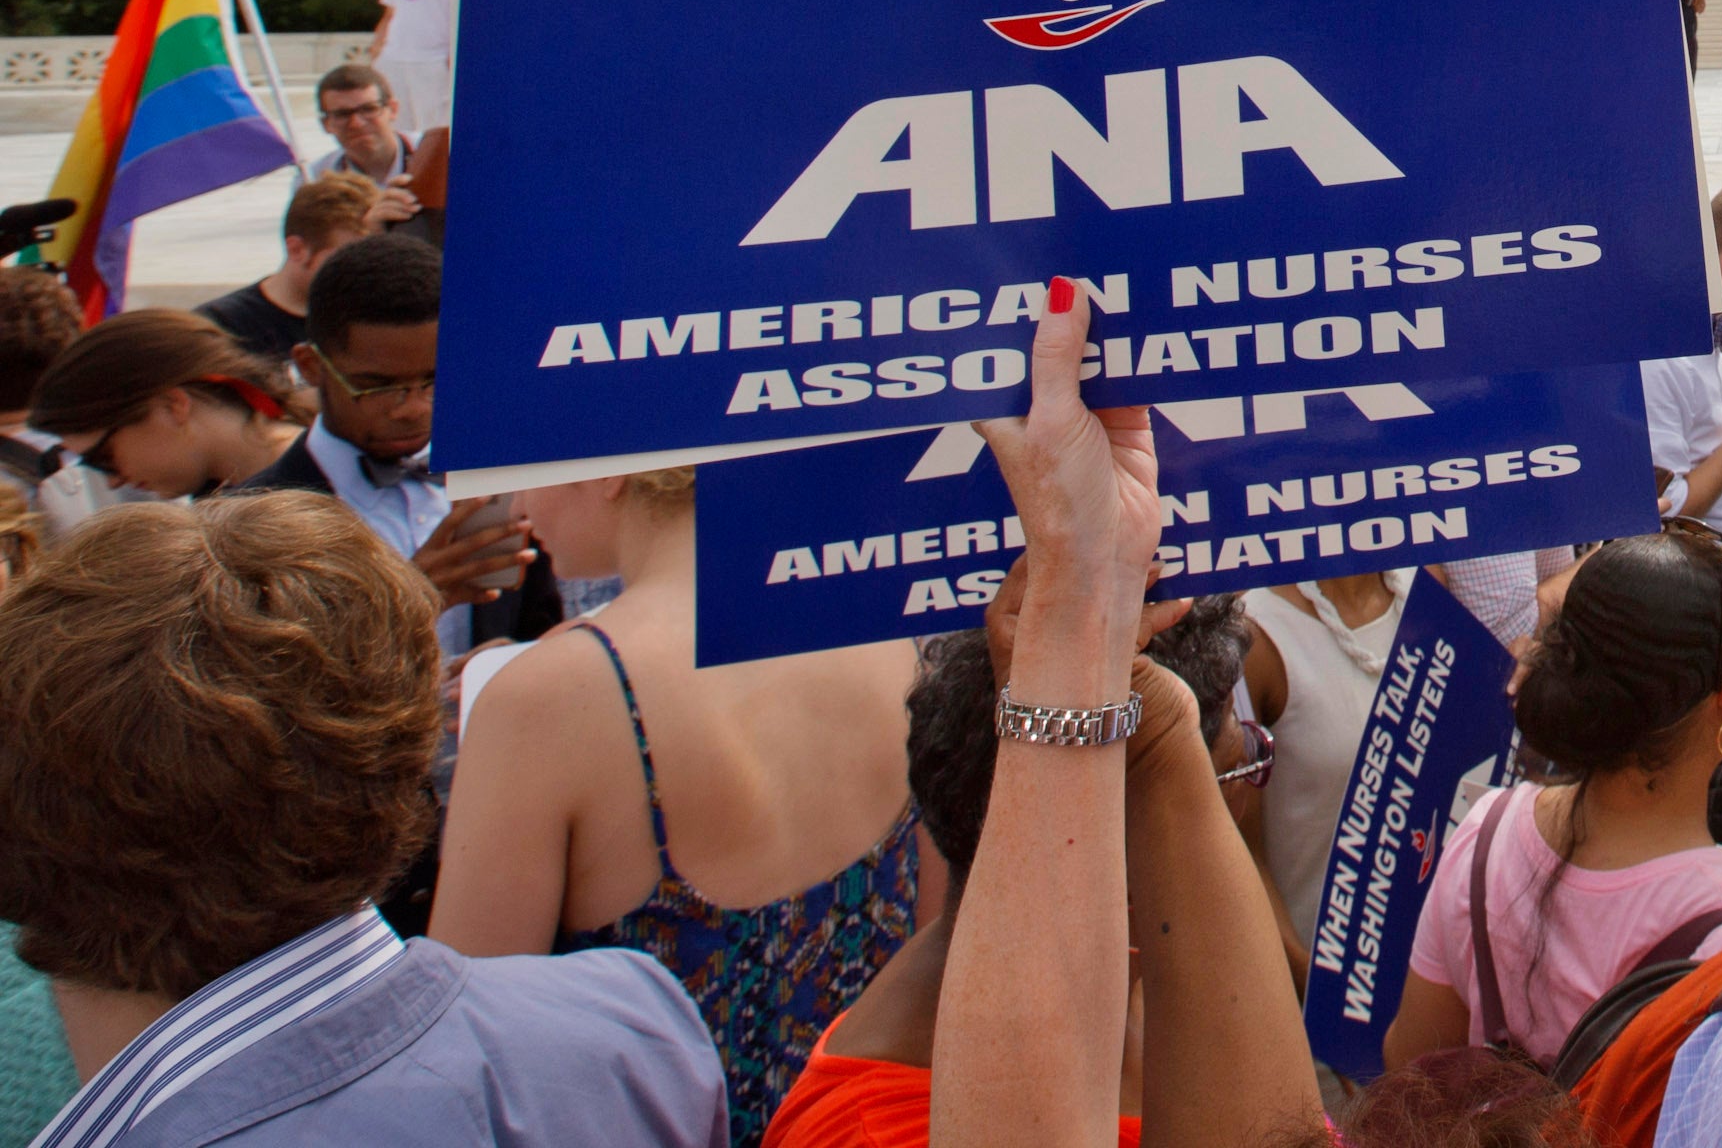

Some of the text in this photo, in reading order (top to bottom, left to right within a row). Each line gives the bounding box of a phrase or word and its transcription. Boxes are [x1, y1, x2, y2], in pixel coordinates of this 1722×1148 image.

[738, 54, 1406, 247] ANA
[539, 224, 1602, 369] AMERICAN NURSES
[765, 444, 1581, 584] AMERIN NURSES
